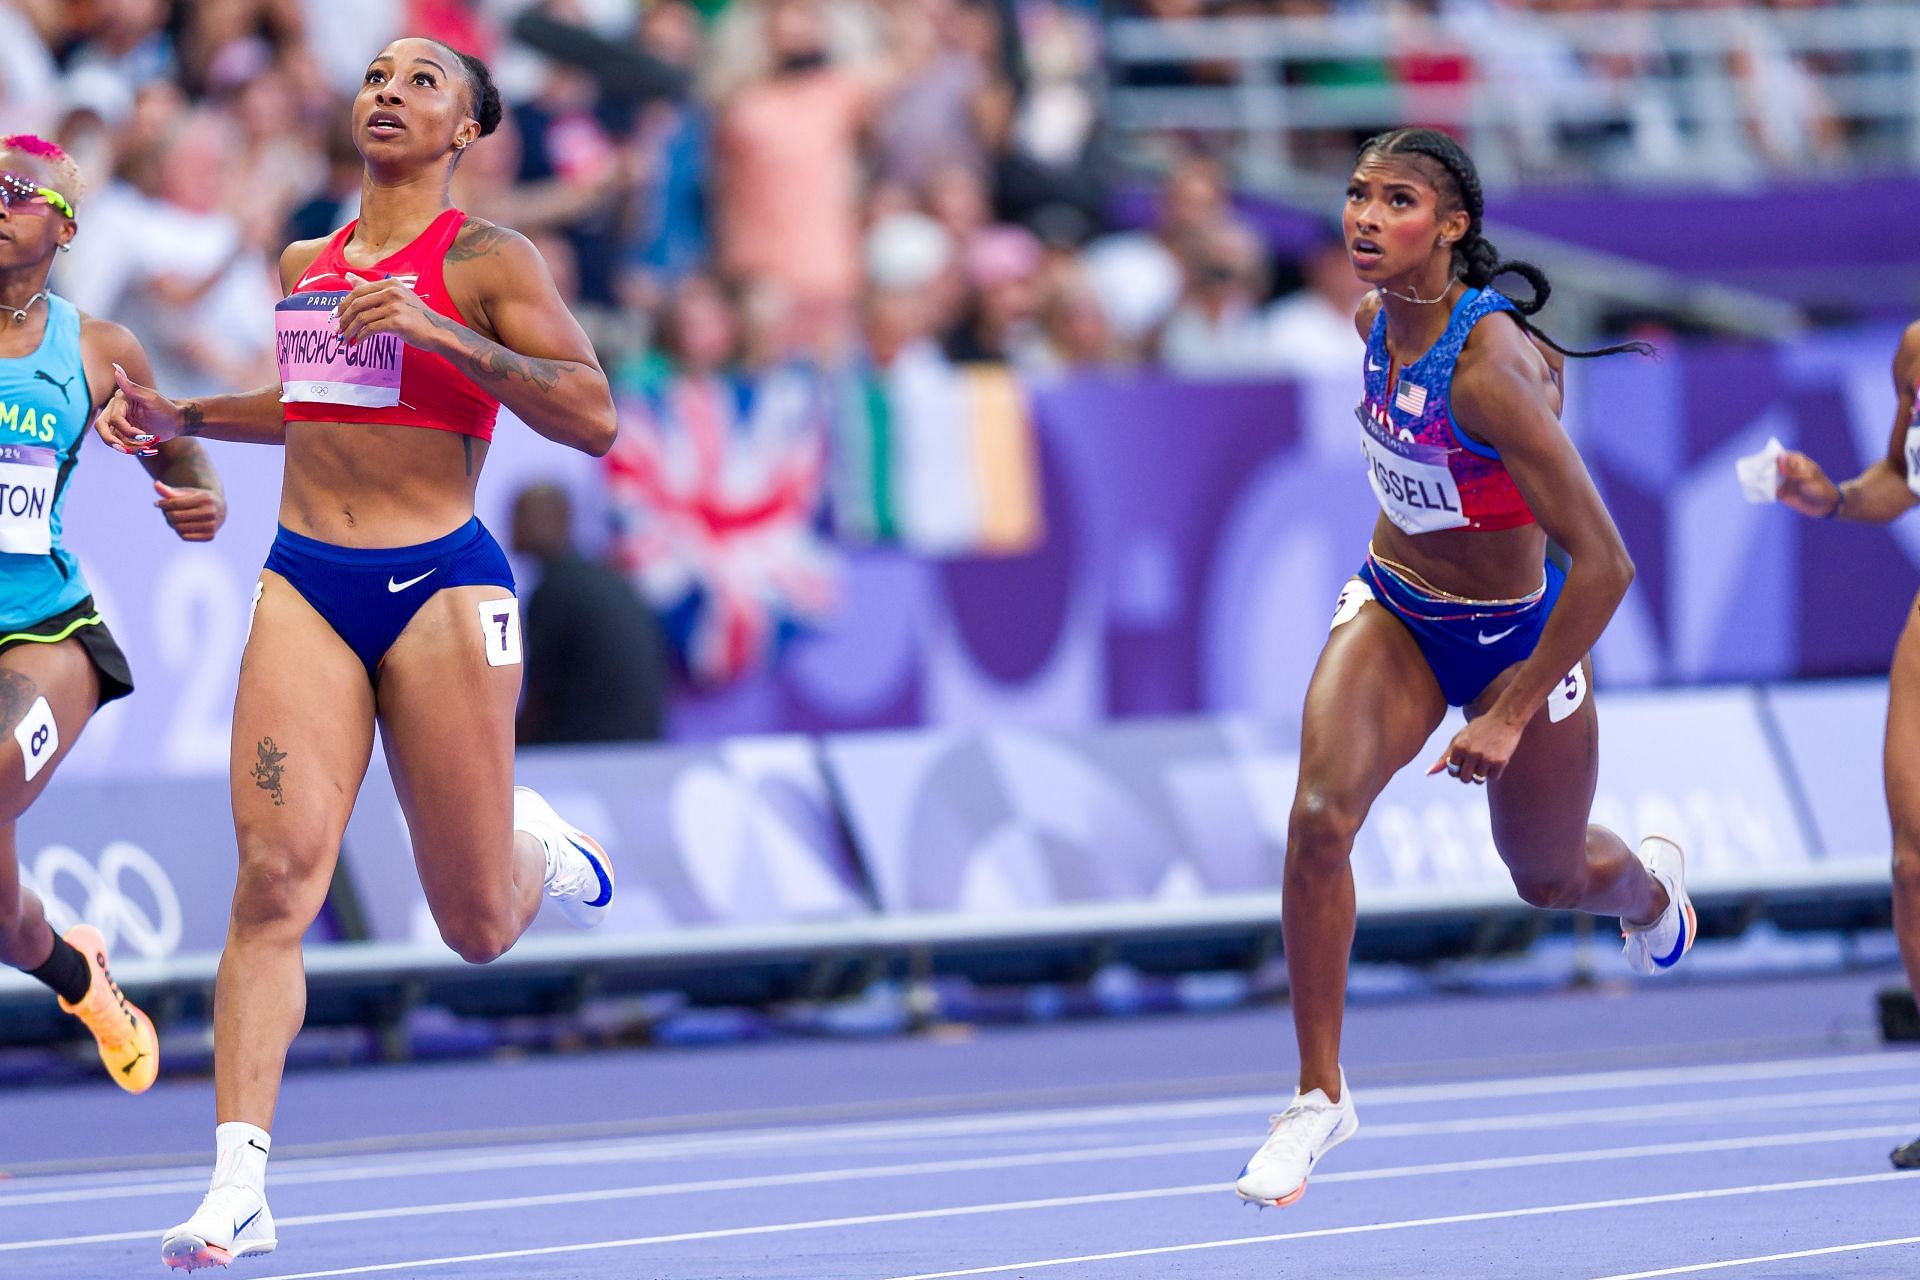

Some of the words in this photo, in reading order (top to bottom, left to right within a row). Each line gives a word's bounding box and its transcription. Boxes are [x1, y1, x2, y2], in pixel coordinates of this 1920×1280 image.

[307, 296, 338, 306] PARIS
[277, 329, 398, 371] CAMACHO-QUINN
[0, 401, 57, 442] MAS
[0, 483, 46, 519] TON
[492, 612, 510, 651] 7
[1564, 673, 1578, 701] 5
[31, 723, 49, 755] 8
